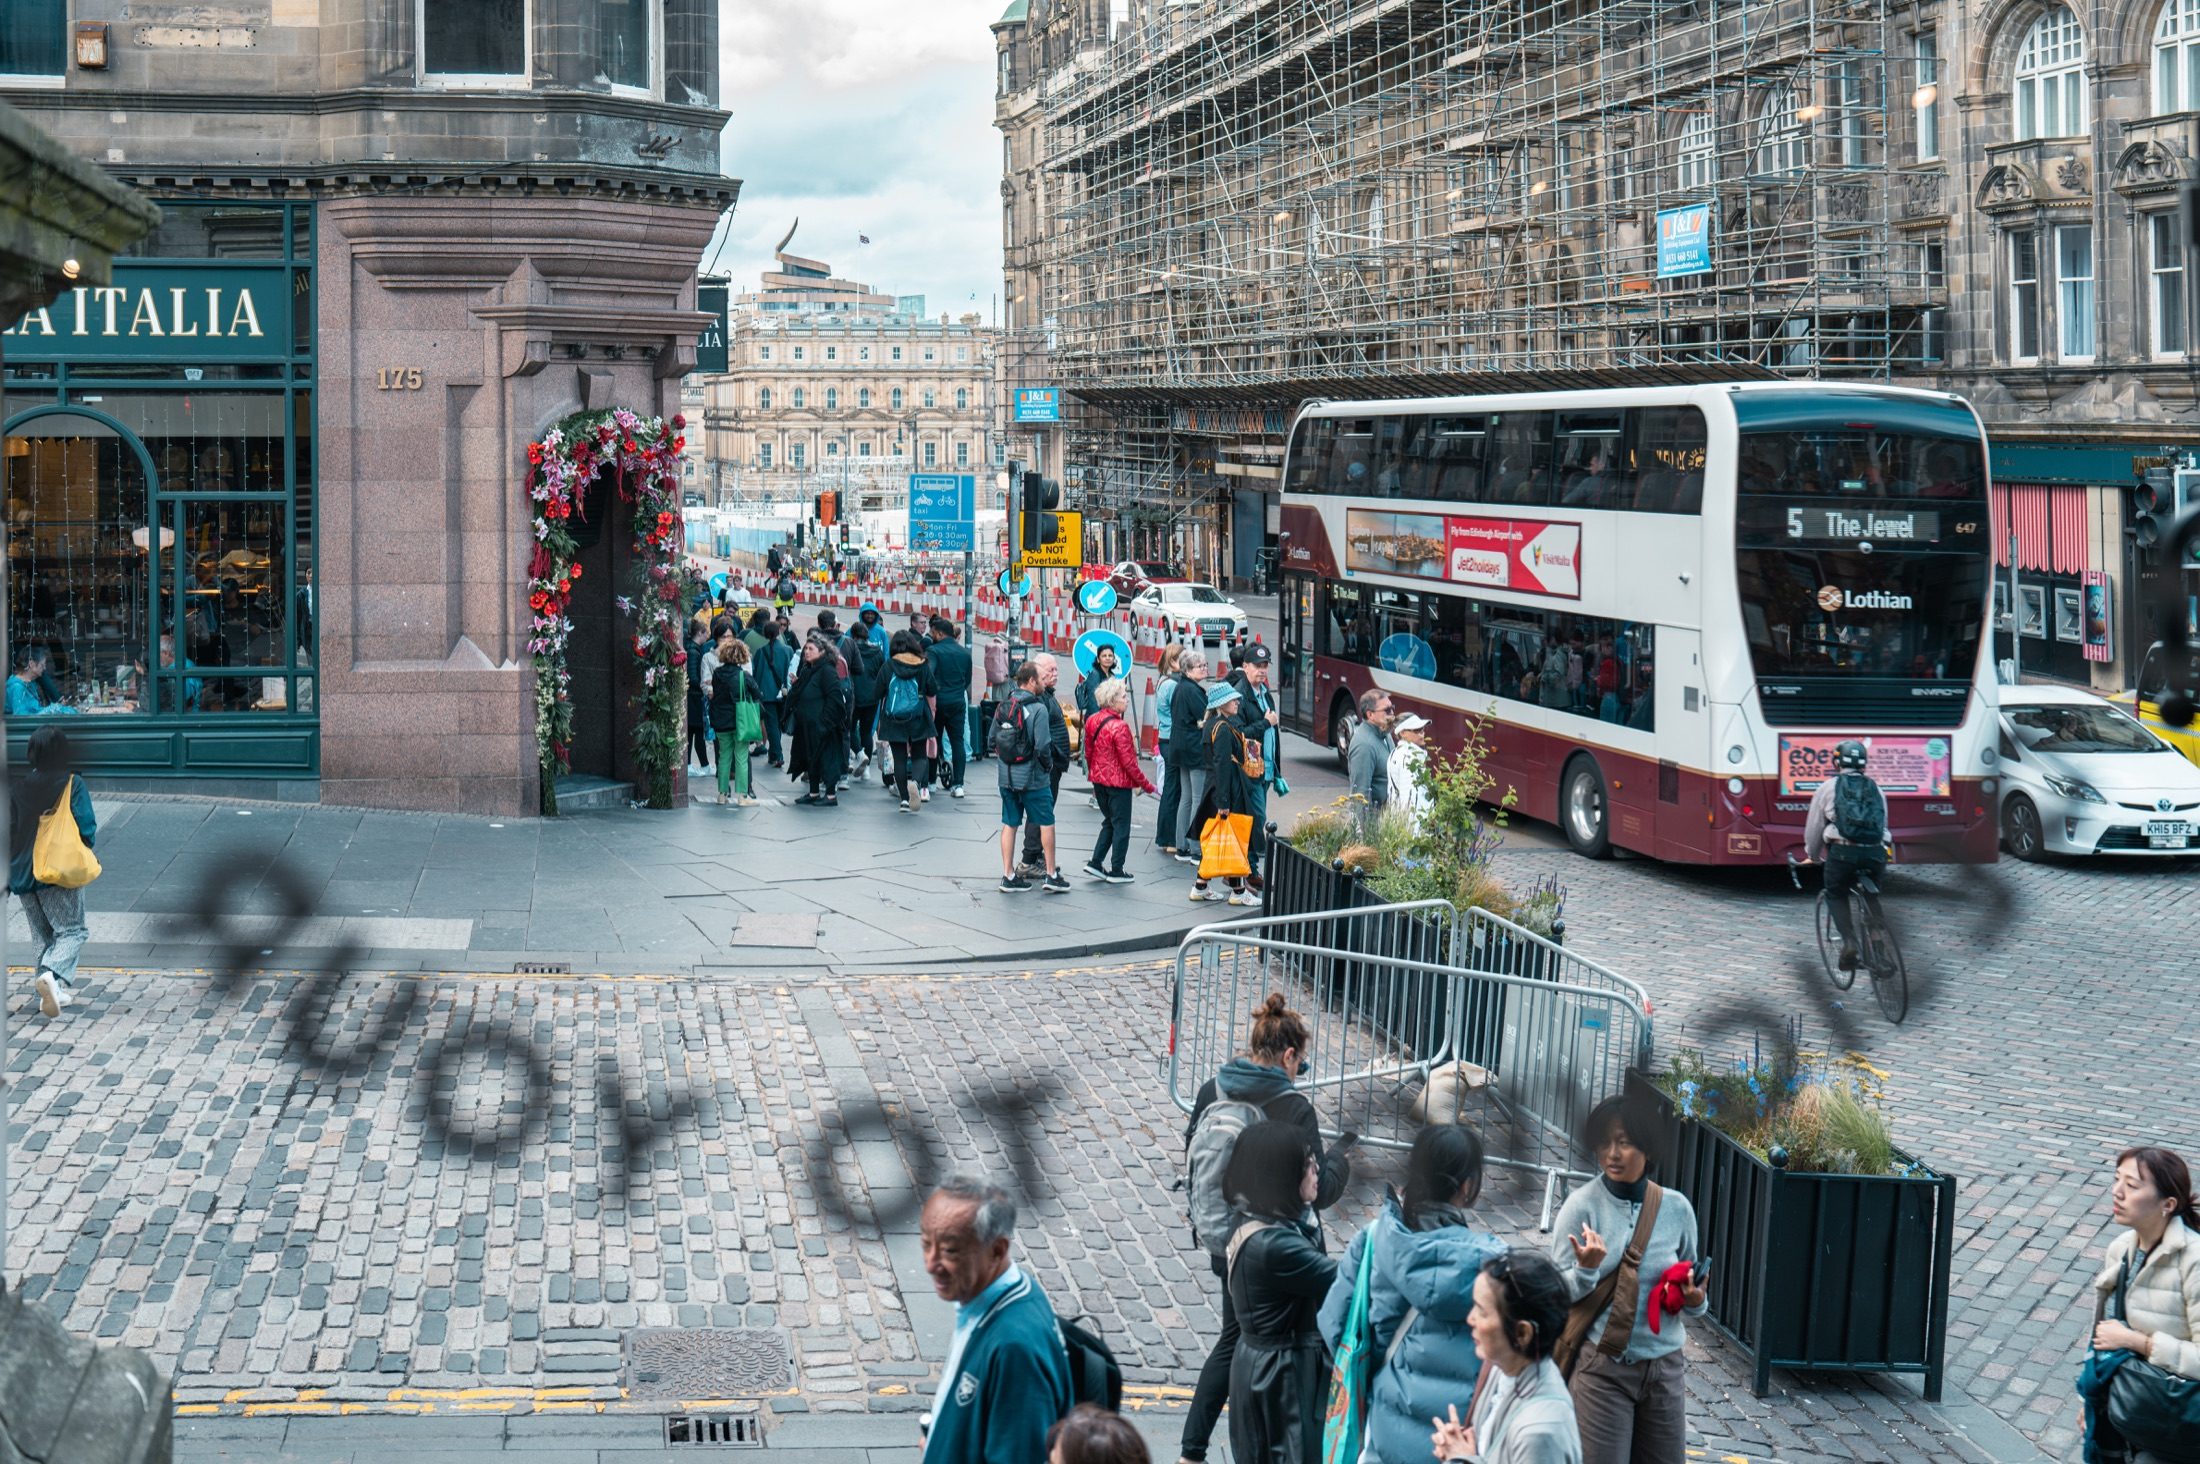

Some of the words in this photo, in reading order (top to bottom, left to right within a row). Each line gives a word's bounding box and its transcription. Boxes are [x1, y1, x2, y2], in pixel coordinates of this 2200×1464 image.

[1671, 212, 1692, 240] J&I
[72, 287, 264, 337] ITALIA
[377, 367, 422, 390] 175
[1027, 390, 1044, 403] J&I
[1787, 508, 1803, 538] 5
[1826, 512, 1861, 537] The
[1863, 513, 1914, 538] Jewel
[1955, 523, 1977, 533] 647
[1046, 546, 1064, 554] NOT
[1027, 557, 1068, 565] Overtake
[1333, 584, 1339, 599] 5
[1845, 590, 1912, 609] Lothian
[1789, 766, 1821, 778] 2025
[1775, 803, 1809, 812] VOLV
[2147, 824, 2170, 834] KH15
[2172, 824, 2191, 834] BFZ
